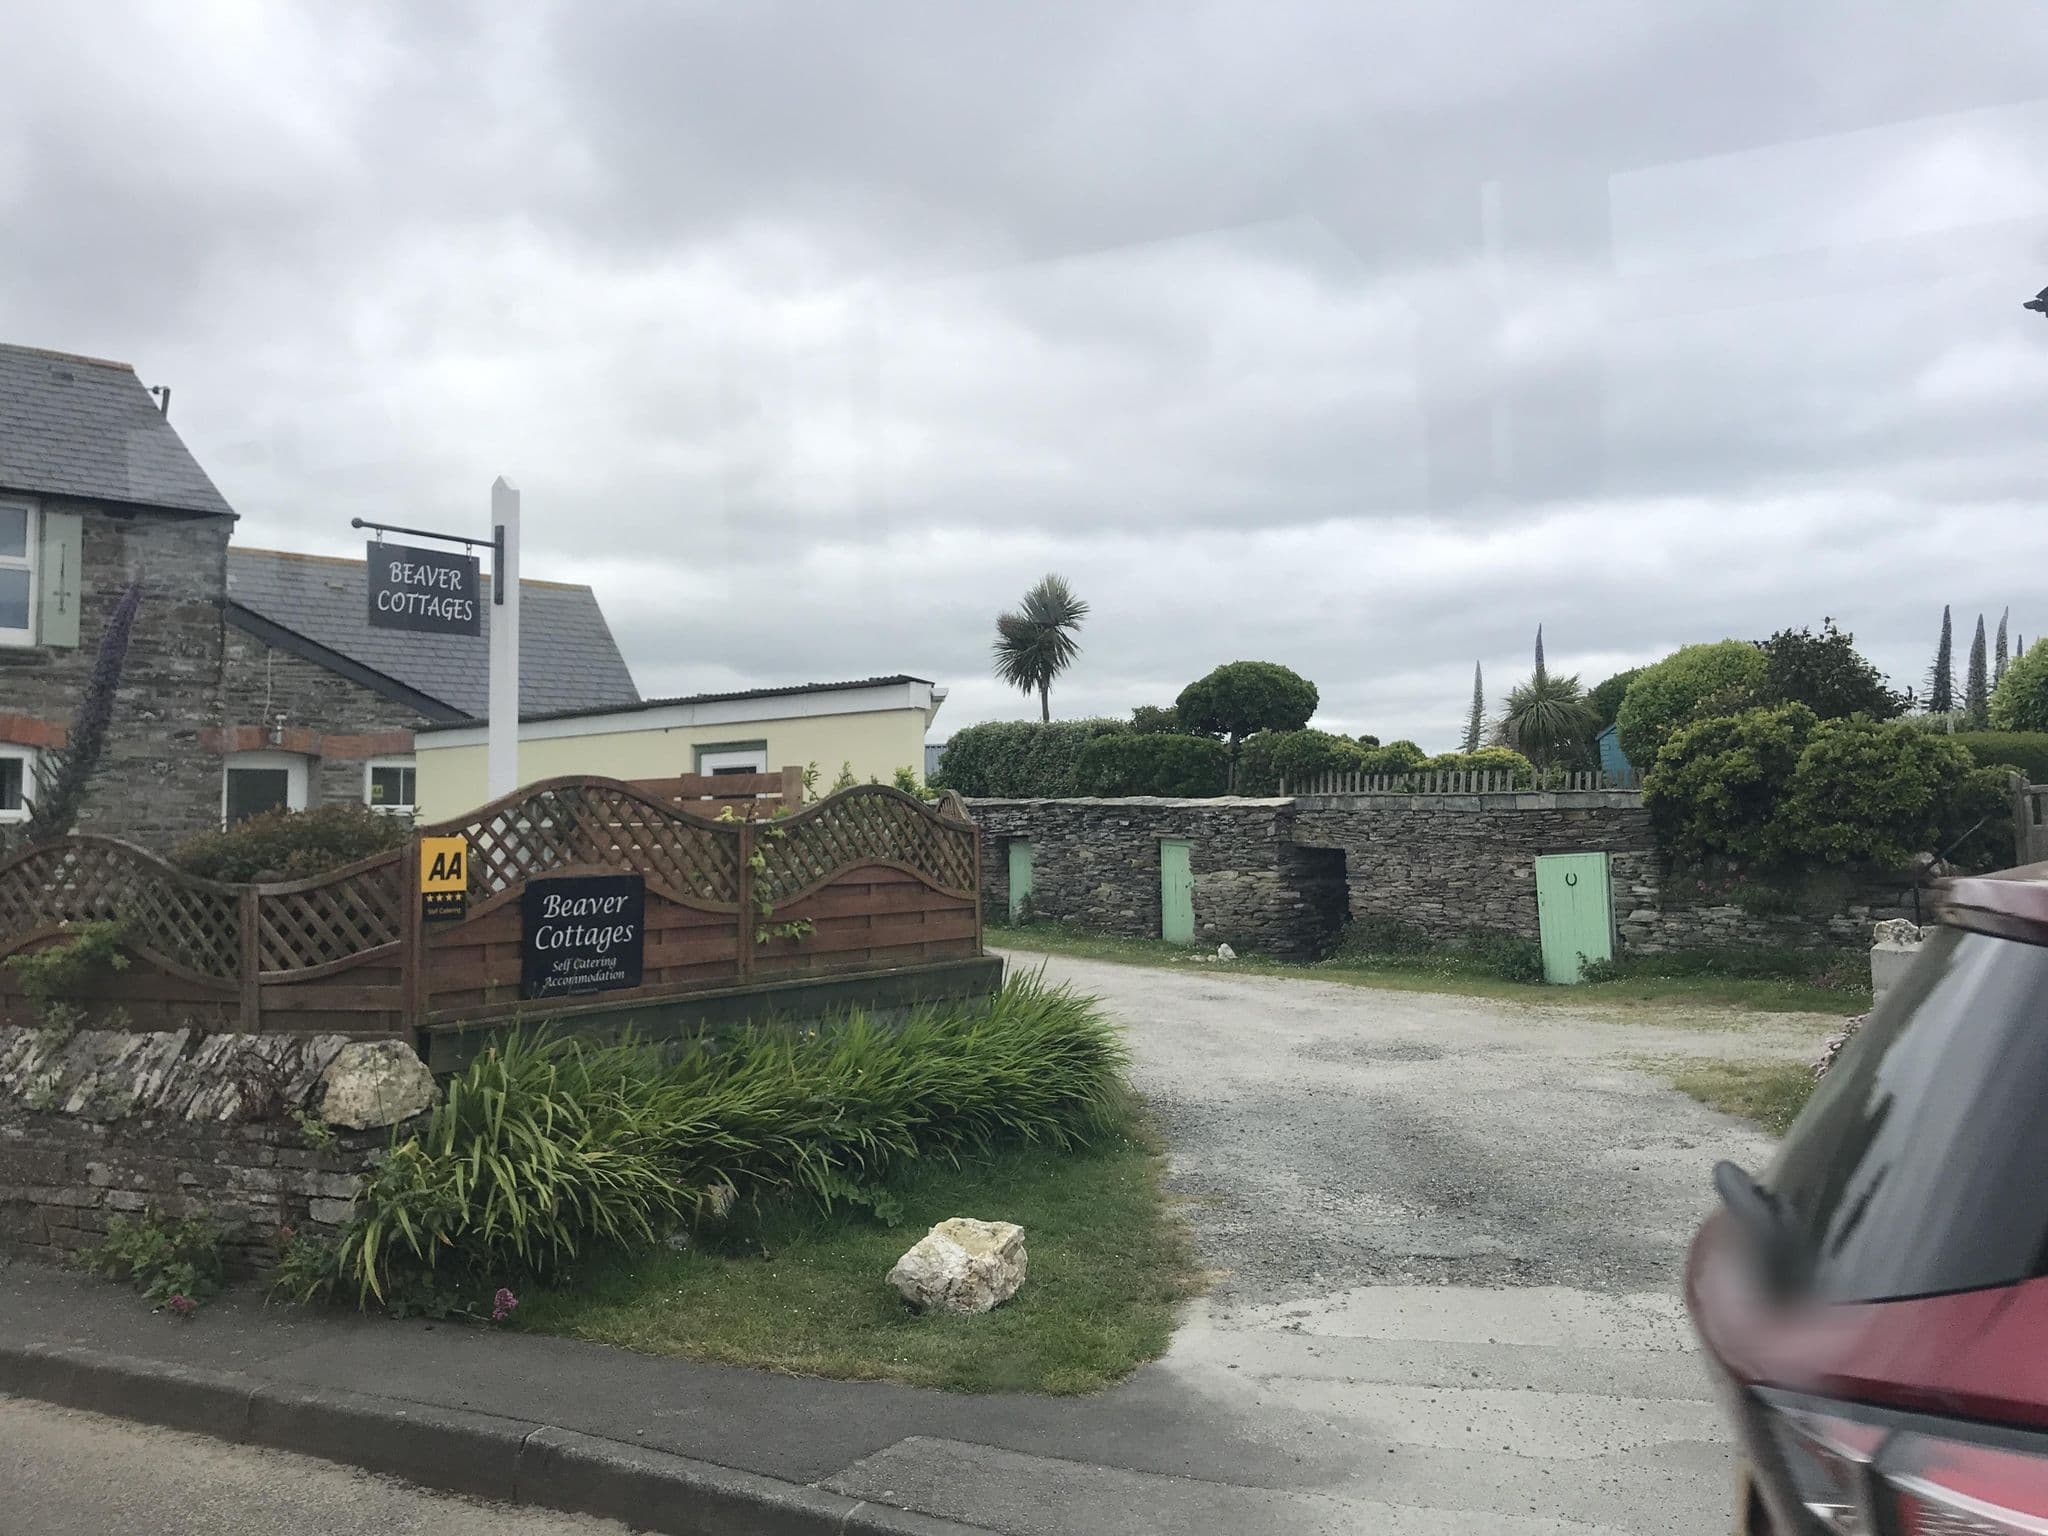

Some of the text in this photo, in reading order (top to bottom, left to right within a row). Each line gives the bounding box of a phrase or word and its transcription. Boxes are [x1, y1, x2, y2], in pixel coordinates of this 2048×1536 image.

[389, 561, 462, 591] BEAVER
[377, 589, 473, 621] COTTAGES
[428, 852, 462, 881] AA
[543, 893, 629, 919] Beaver
[535, 923, 634, 953] Cottages
[542, 969, 625, 989] Accommodation
[552, 956, 617, 975] Self Catering
